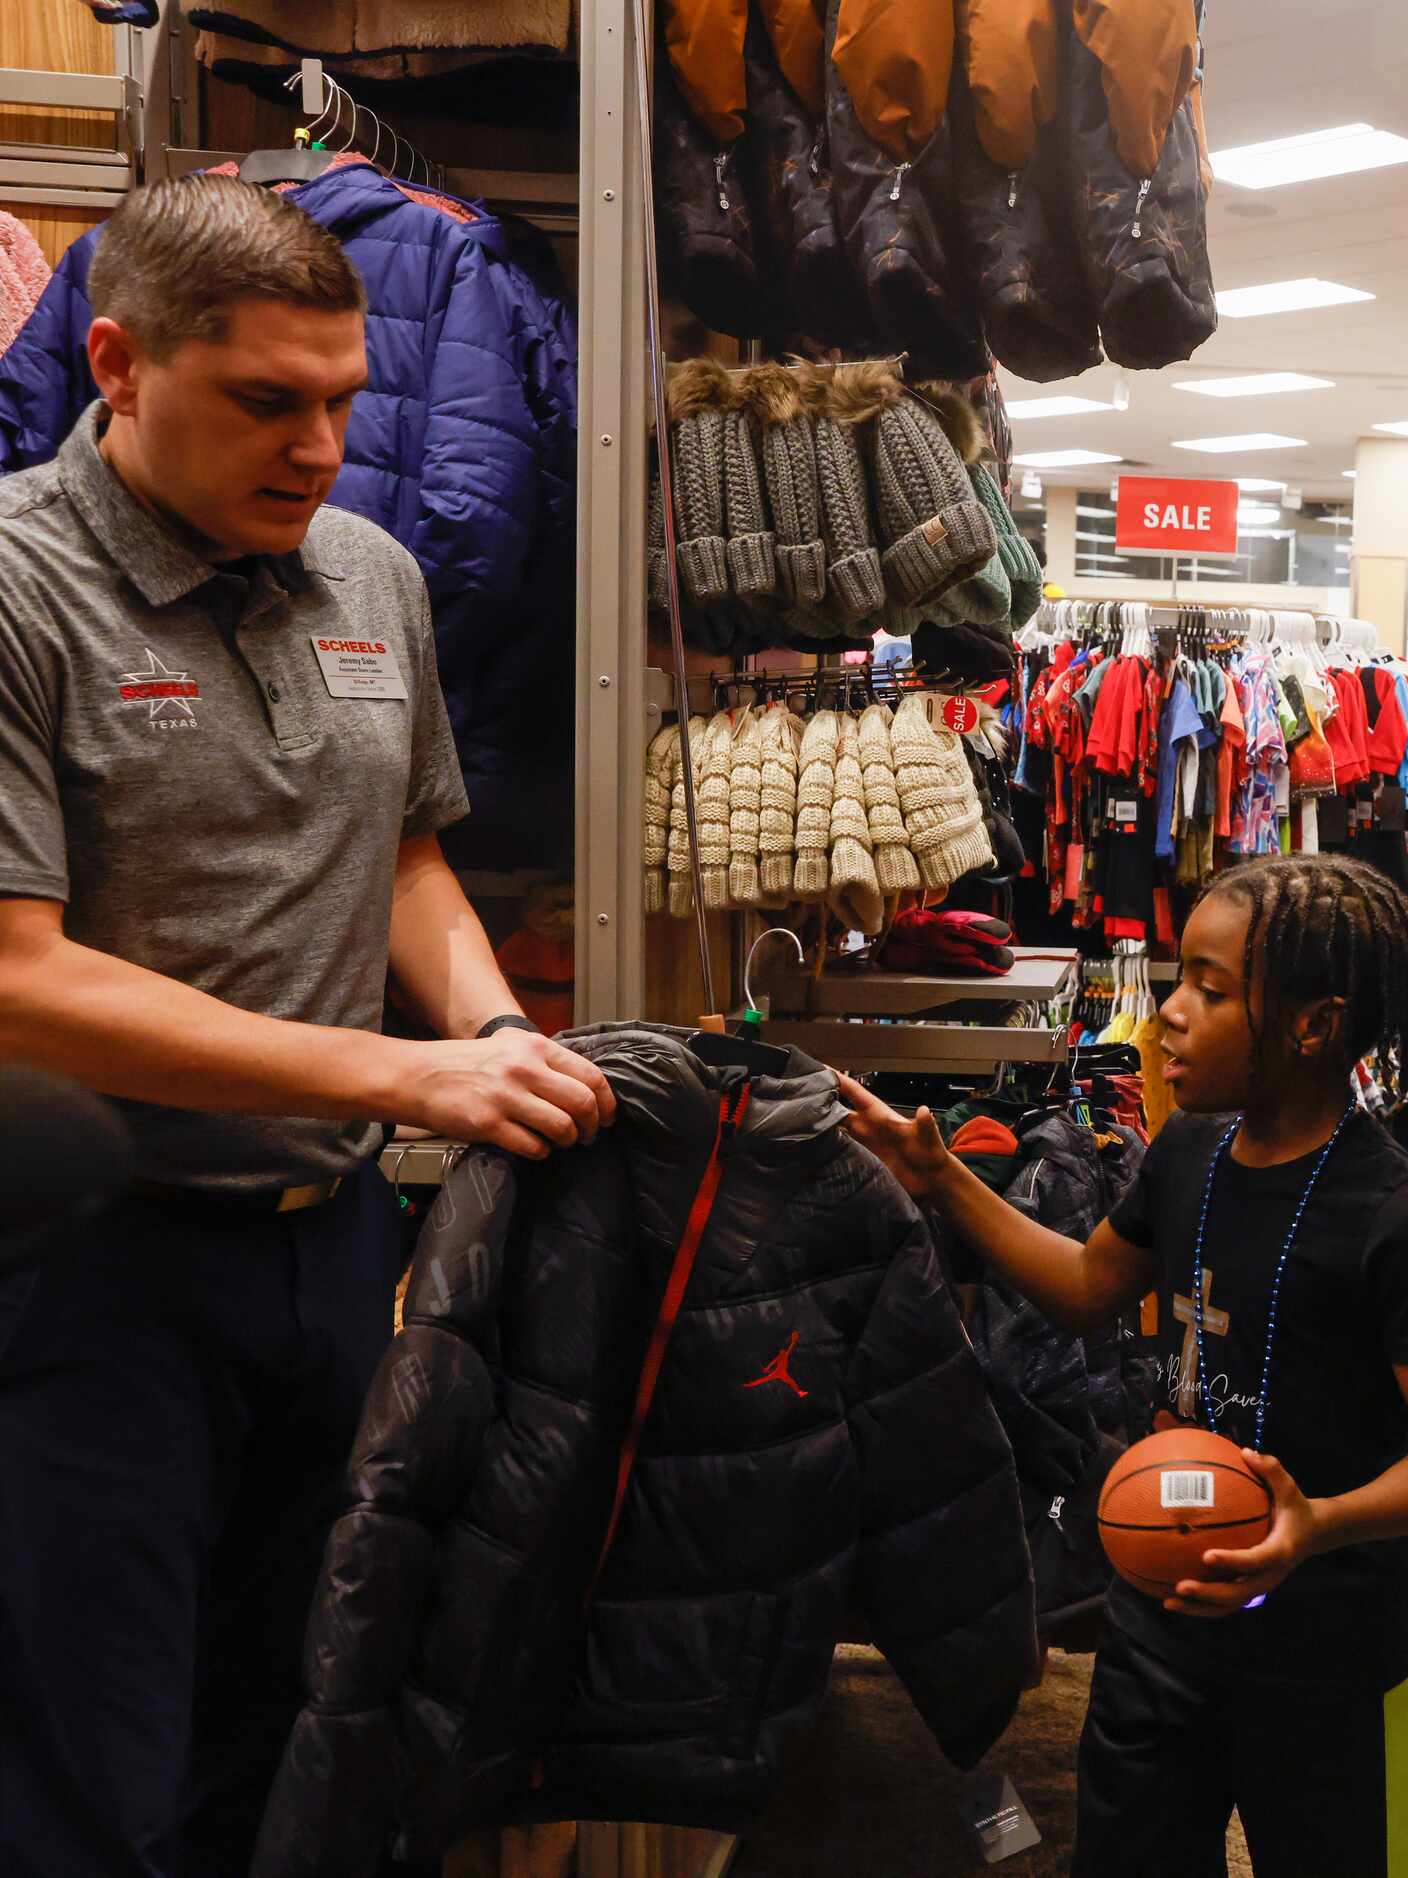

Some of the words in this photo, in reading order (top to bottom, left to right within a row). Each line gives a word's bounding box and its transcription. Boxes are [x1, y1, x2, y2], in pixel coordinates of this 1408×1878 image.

[1143, 503, 1212, 531] SALE
[317, 639, 387, 654] SCHEELS
[953, 697, 966, 731] SALE
[148, 718, 199, 732] TEXAS
